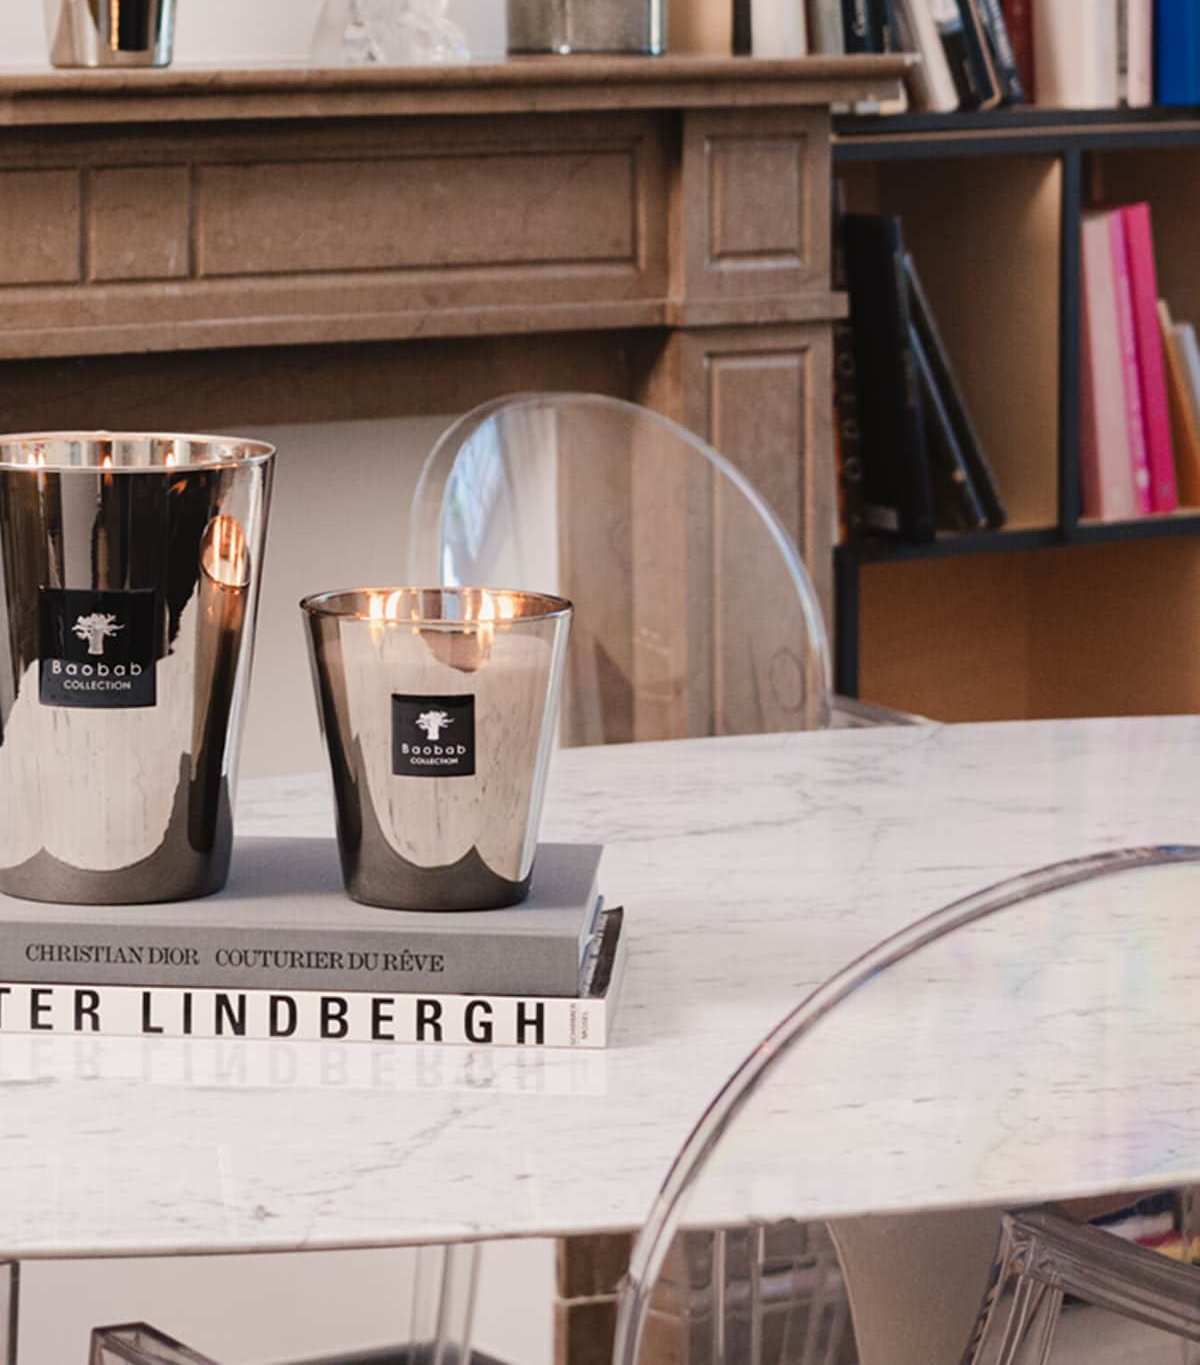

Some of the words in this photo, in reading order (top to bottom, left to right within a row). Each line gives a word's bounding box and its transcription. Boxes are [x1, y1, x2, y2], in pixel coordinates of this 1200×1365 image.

[52, 659, 142, 677] Baobab
[63, 680, 131, 690] COLLECTION
[401, 742, 466, 756] Baobab
[26, 943, 143, 965] CHRISTIAN
[149, 946, 200, 966] DIOR
[215, 948, 344, 971] COUTURIER
[349, 952, 379, 971] DU
[383, 948, 445, 973] RÊVE
[142, 990, 545, 1045] LINDBERGH
